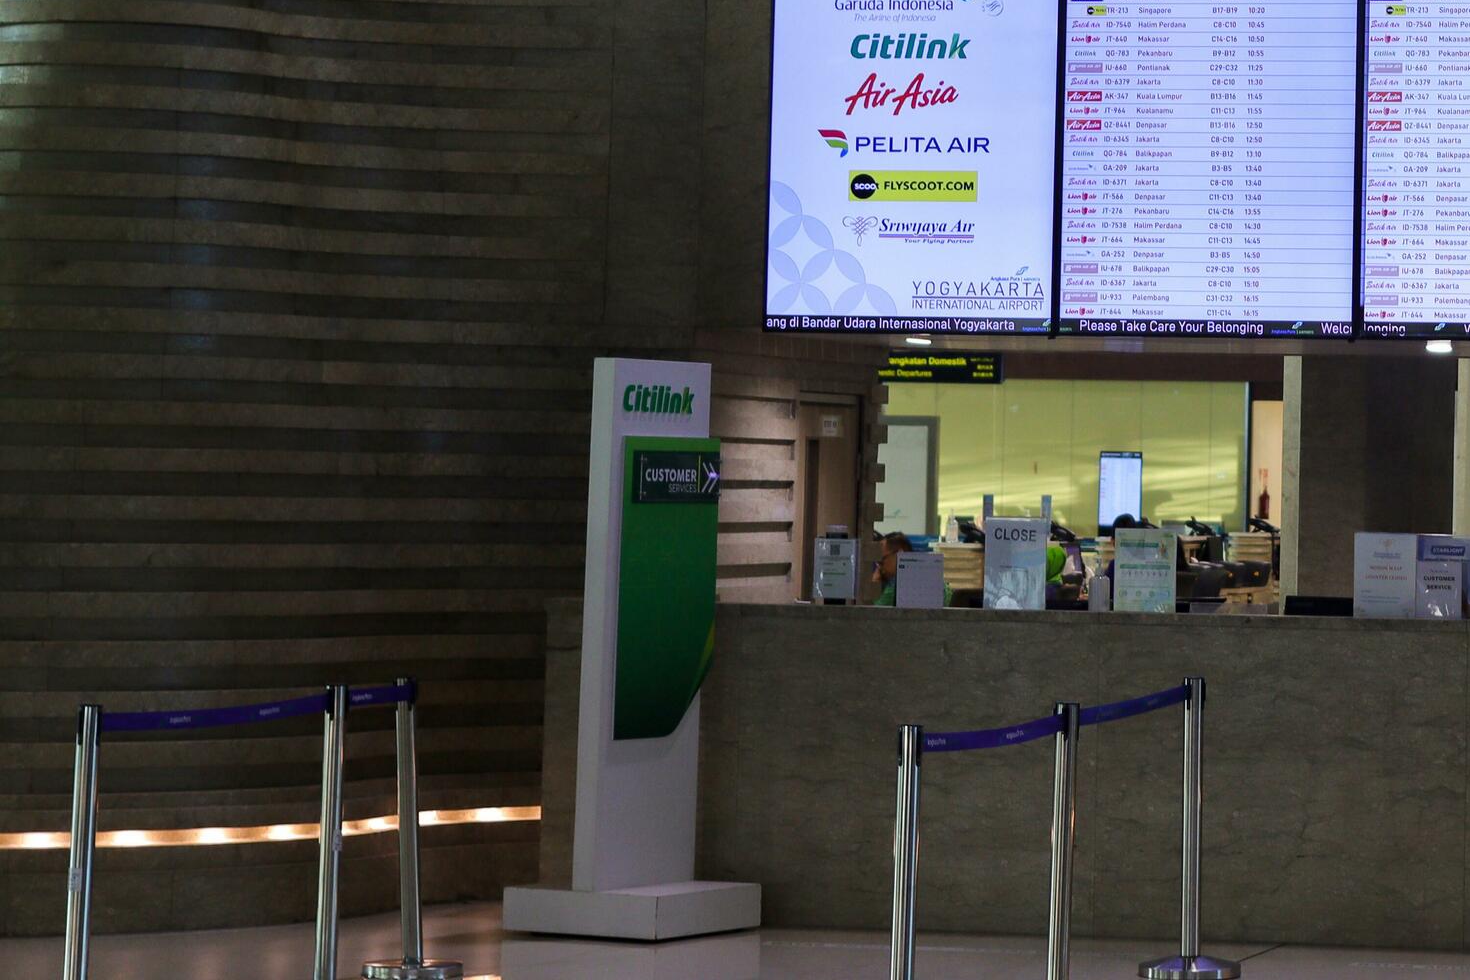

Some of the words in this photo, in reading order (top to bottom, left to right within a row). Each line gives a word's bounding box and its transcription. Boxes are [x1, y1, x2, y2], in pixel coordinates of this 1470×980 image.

[850, 33, 971, 59] Citilink
[856, 137, 941, 153] PELITA
[947, 137, 990, 154] AIR
[884, 181, 974, 192] FLYSCOOT.COM
[879, 218, 947, 236] Sriwijaya
[951, 219, 975, 233] Air
[912, 281, 1044, 297] YOGYAKARTA
[912, 299, 995, 310] INTERNATIONAL
[998, 300, 1043, 311] AIRPORT
[766, 318, 786, 330] ang
[789, 317, 799, 328] di
[802, 317, 841, 328] Bandar
[844, 317, 876, 328] Udara
[879, 318, 951, 330] Internasional
[954, 318, 1015, 331] Yogyakarta
[1079, 320, 1117, 331] Please
[1120, 321, 1147, 332] Take
[1149, 321, 1175, 332] Care
[1179, 321, 1204, 333] Your
[1207, 321, 1264, 335] Belonging
[928, 356, 967, 366] Domestik
[623, 384, 694, 414] Citilink
[645, 468, 697, 482] CUSTOMER
[668, 483, 697, 493] SERVICES
[994, 528, 1037, 542] CLOSE
